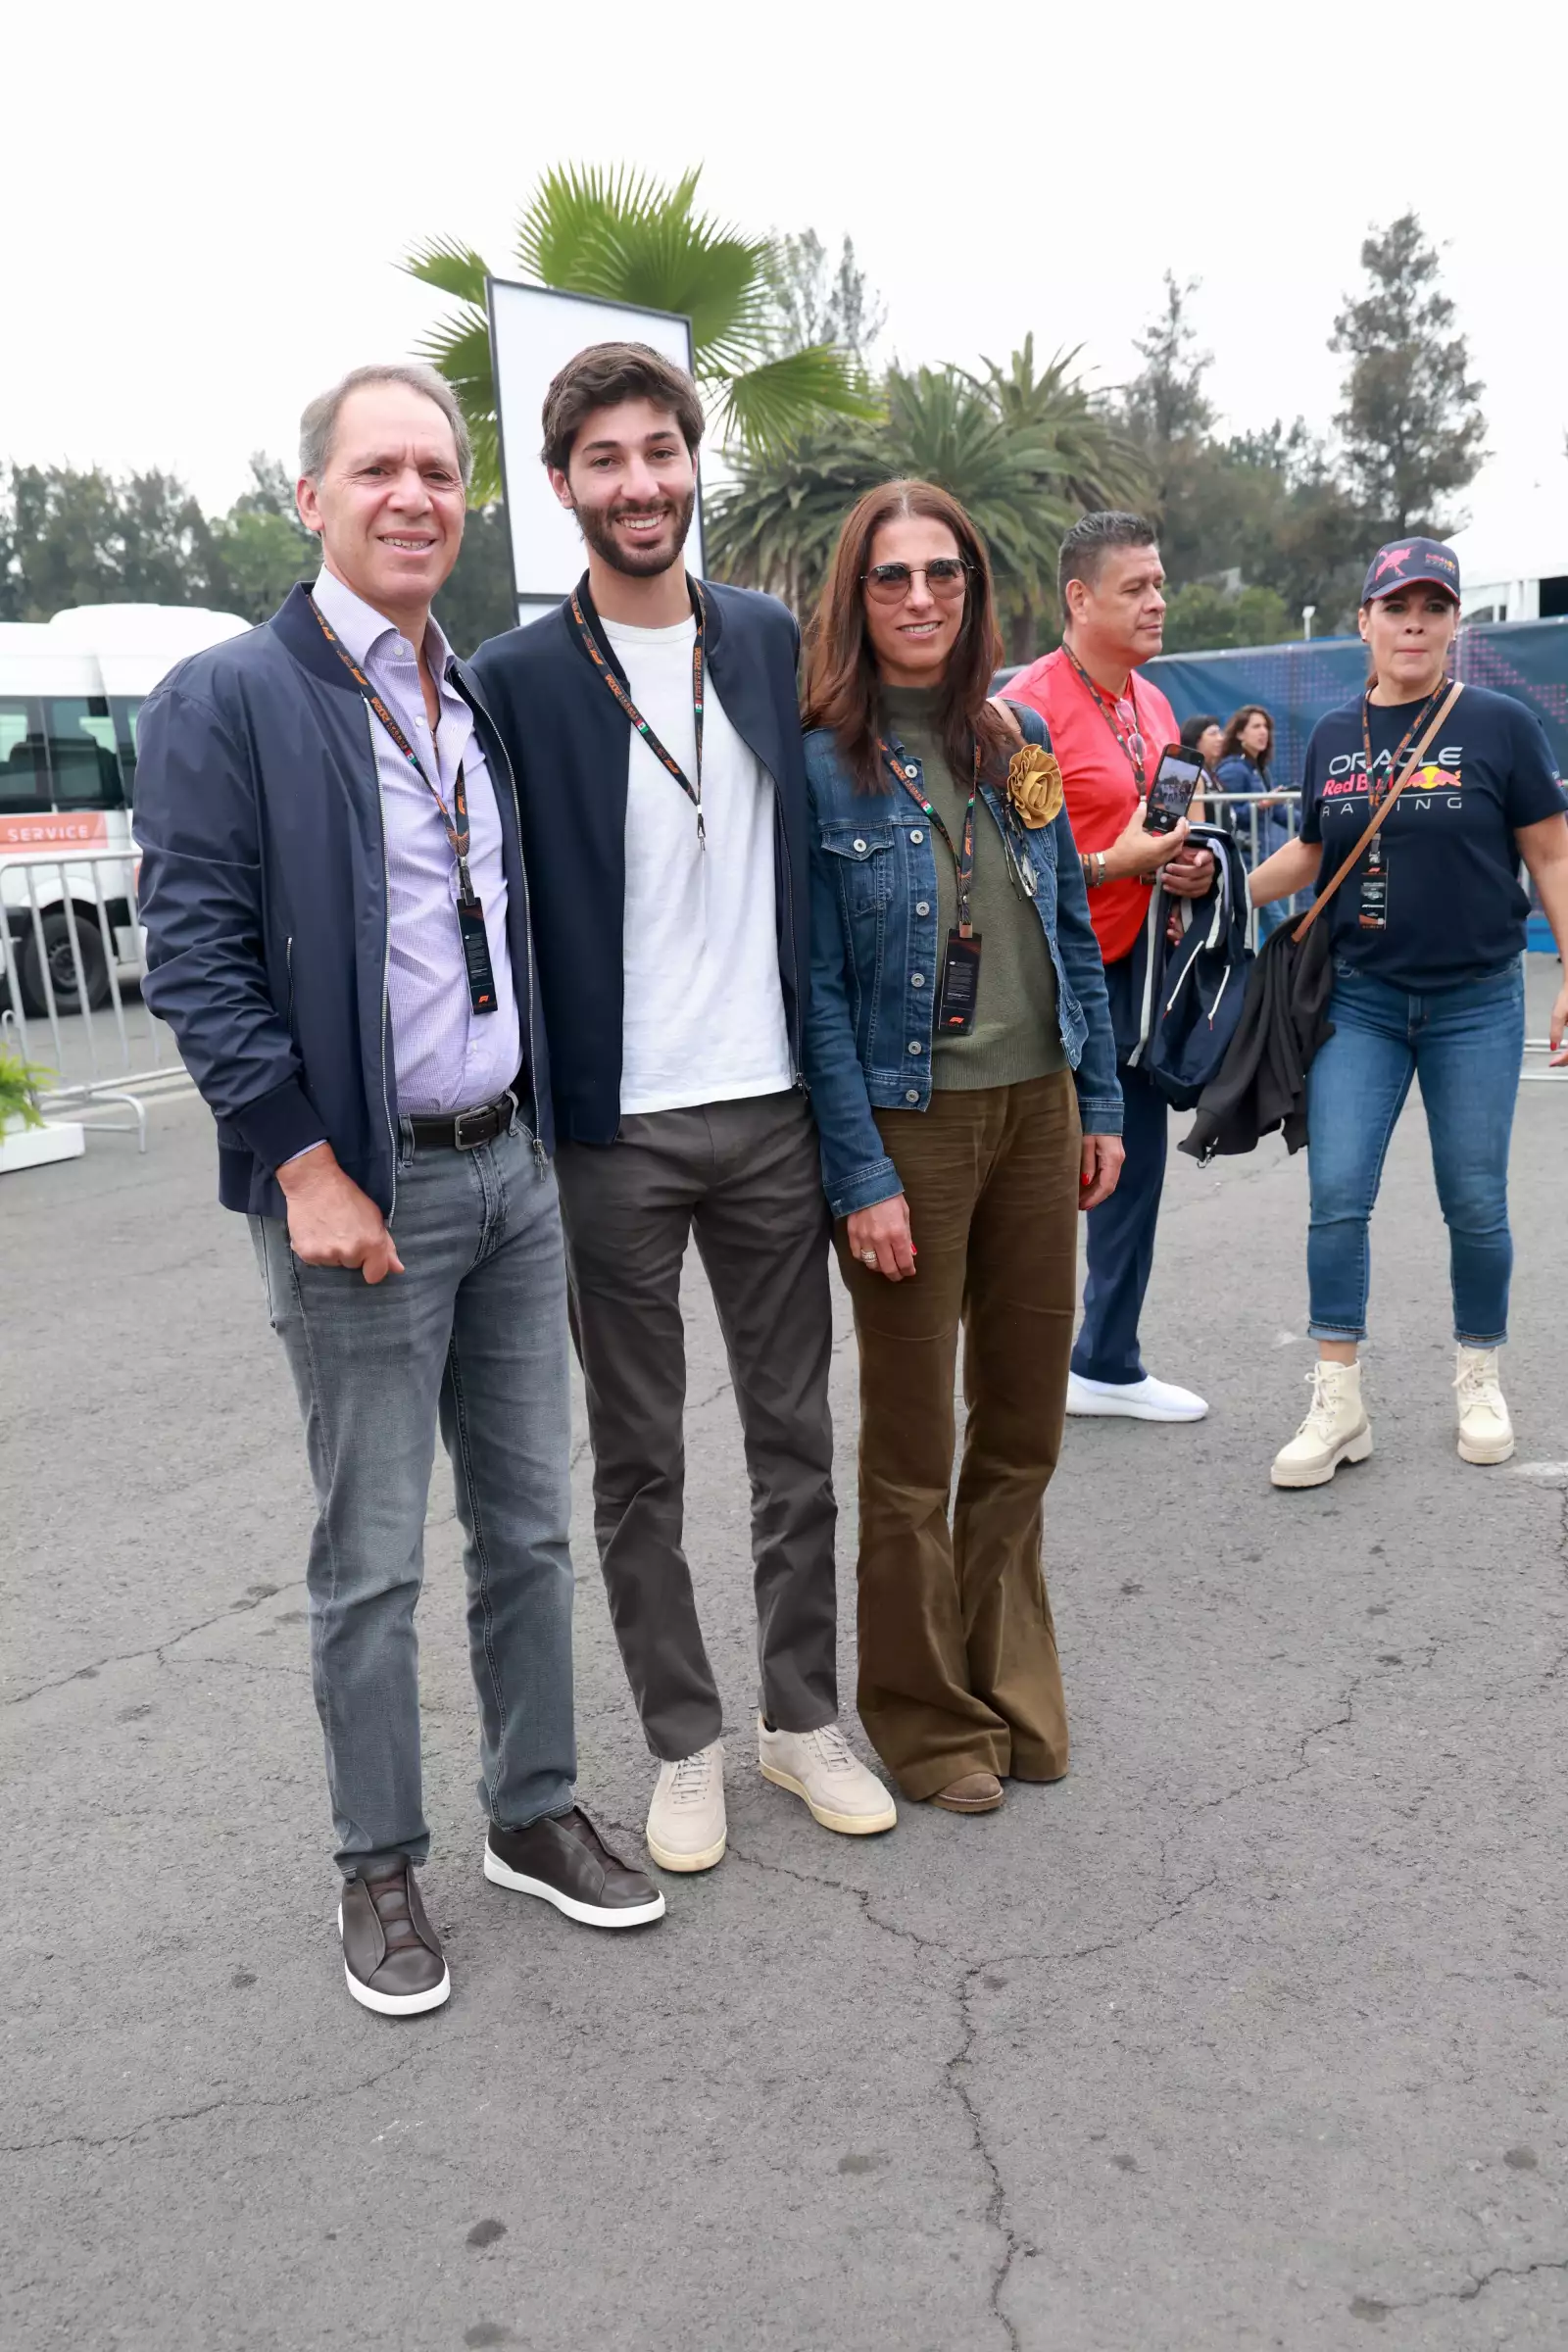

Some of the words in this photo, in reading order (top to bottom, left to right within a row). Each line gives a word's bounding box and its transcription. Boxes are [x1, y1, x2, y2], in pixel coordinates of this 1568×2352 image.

[1322, 773, 1355, 797] Red
[1322, 797, 1462, 818] RAING
[7, 824, 89, 843] SERVICE
